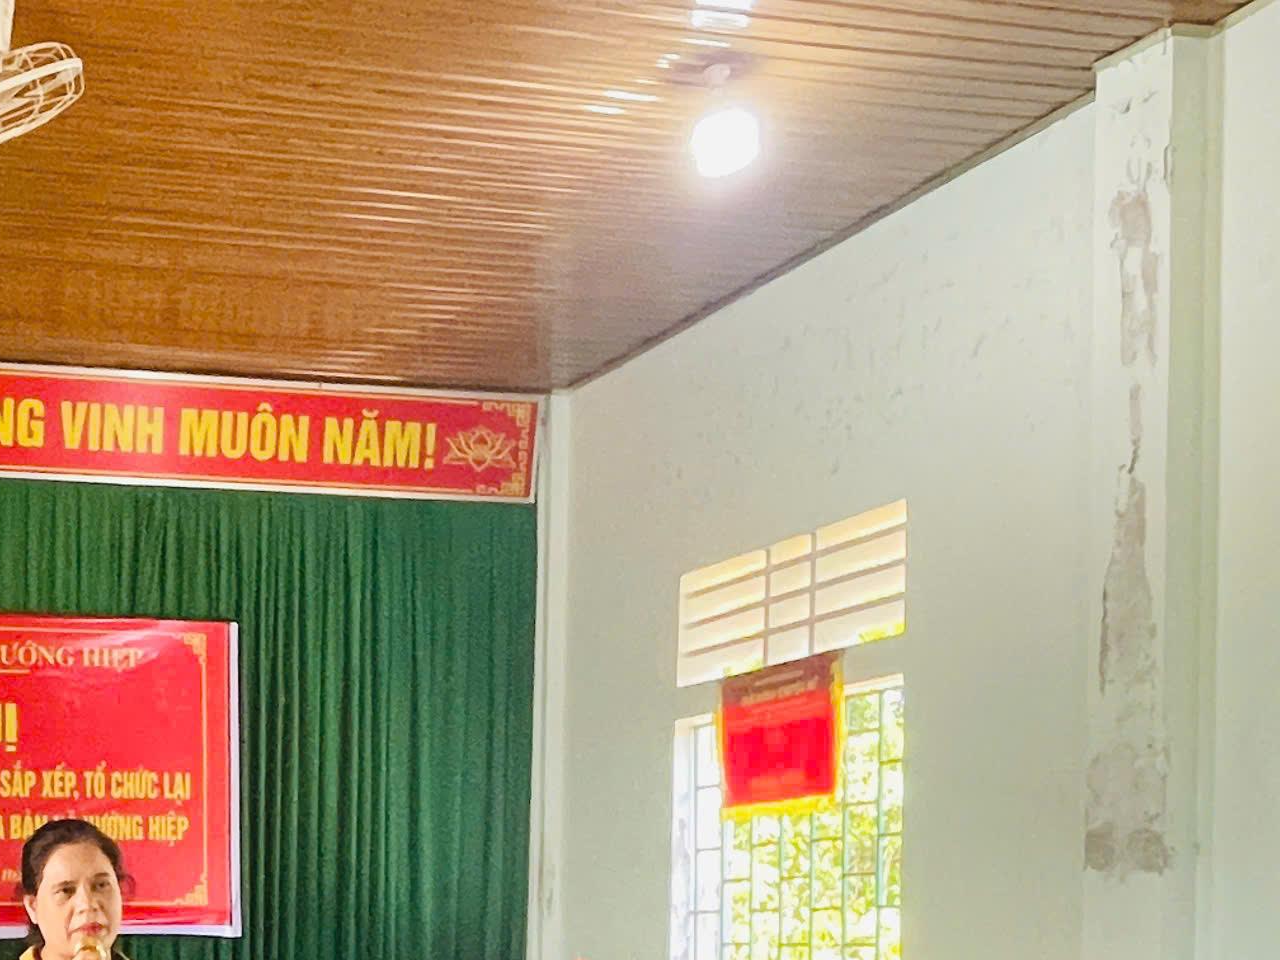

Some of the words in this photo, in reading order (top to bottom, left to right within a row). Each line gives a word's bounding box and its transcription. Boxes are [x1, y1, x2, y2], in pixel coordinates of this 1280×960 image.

[60, 400, 165, 454] VINH
[178, 401, 310, 463] MUÔN
[322, 407, 438, 471] NĂM!
[0, 759, 37, 799] SẮP
[41, 761, 80, 800] XẾP,
[83, 760, 108, 800] TỔ
[110, 763, 161, 800] CHỨC
[163, 771, 192, 807] LẠI
[148, 809, 191, 848] HIỆP
